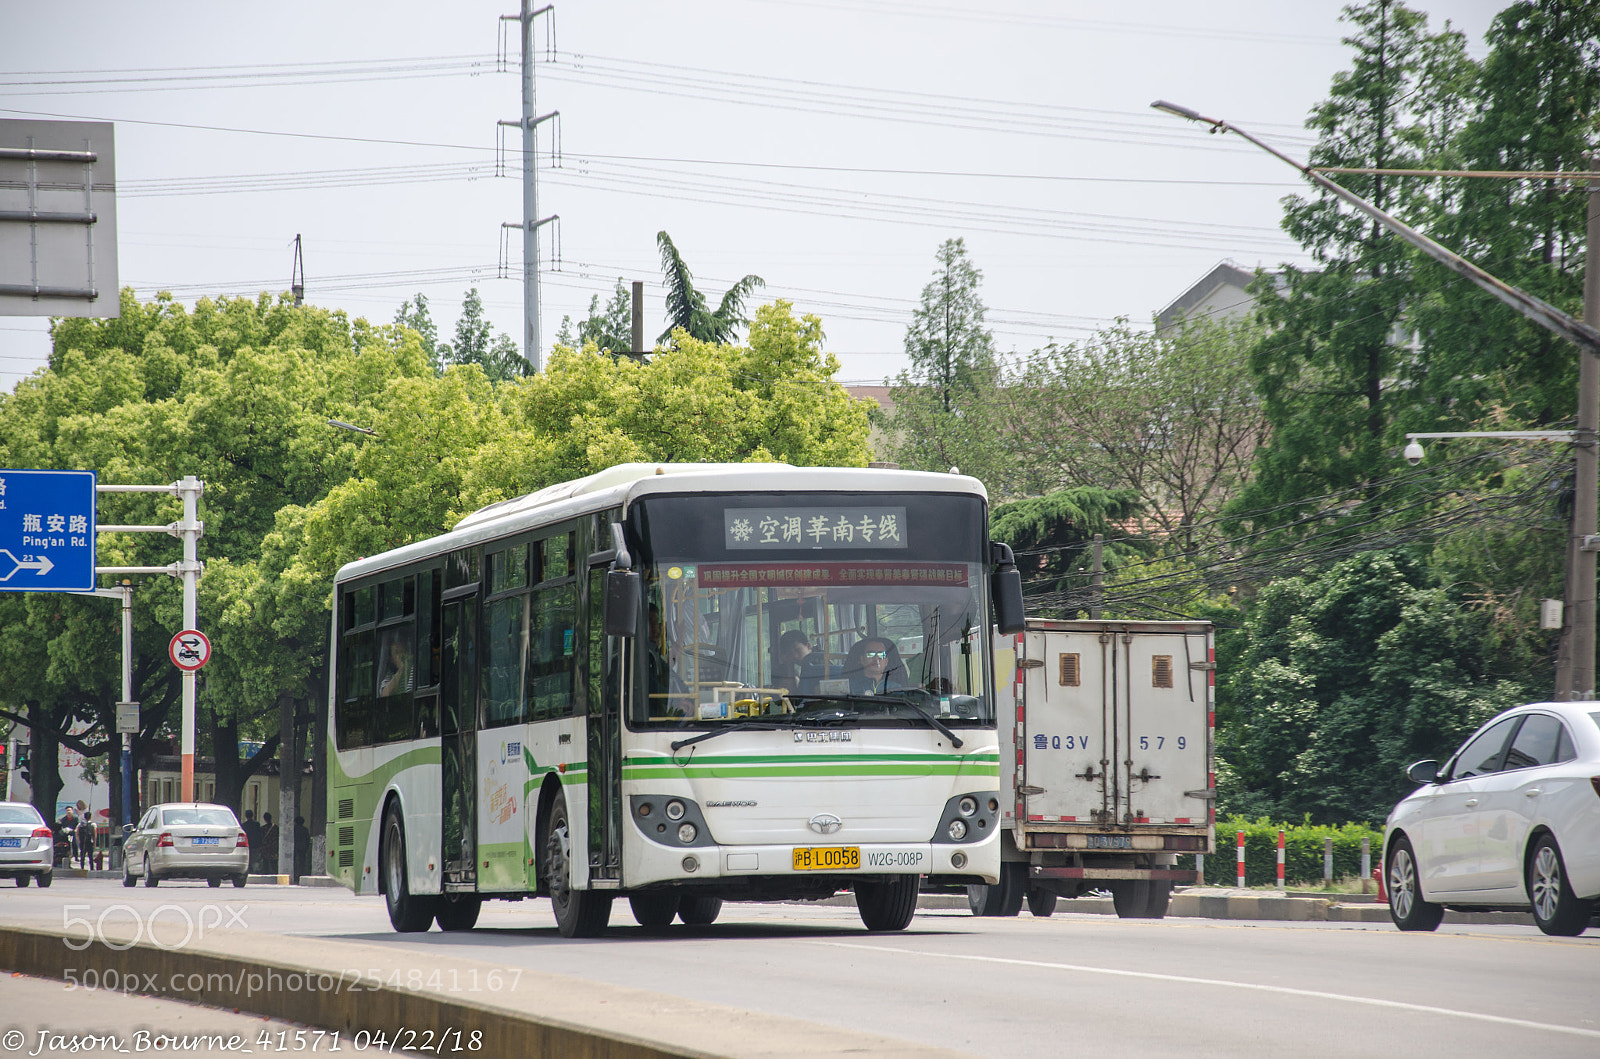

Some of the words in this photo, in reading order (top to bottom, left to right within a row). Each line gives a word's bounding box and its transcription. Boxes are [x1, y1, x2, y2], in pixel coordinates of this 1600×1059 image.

[23, 513, 88, 534] 瓶安路
[23, 536, 65, 549] Ping'an
[71, 537, 88, 547] Rd.
[868, 852, 923, 866] W2G-008P
